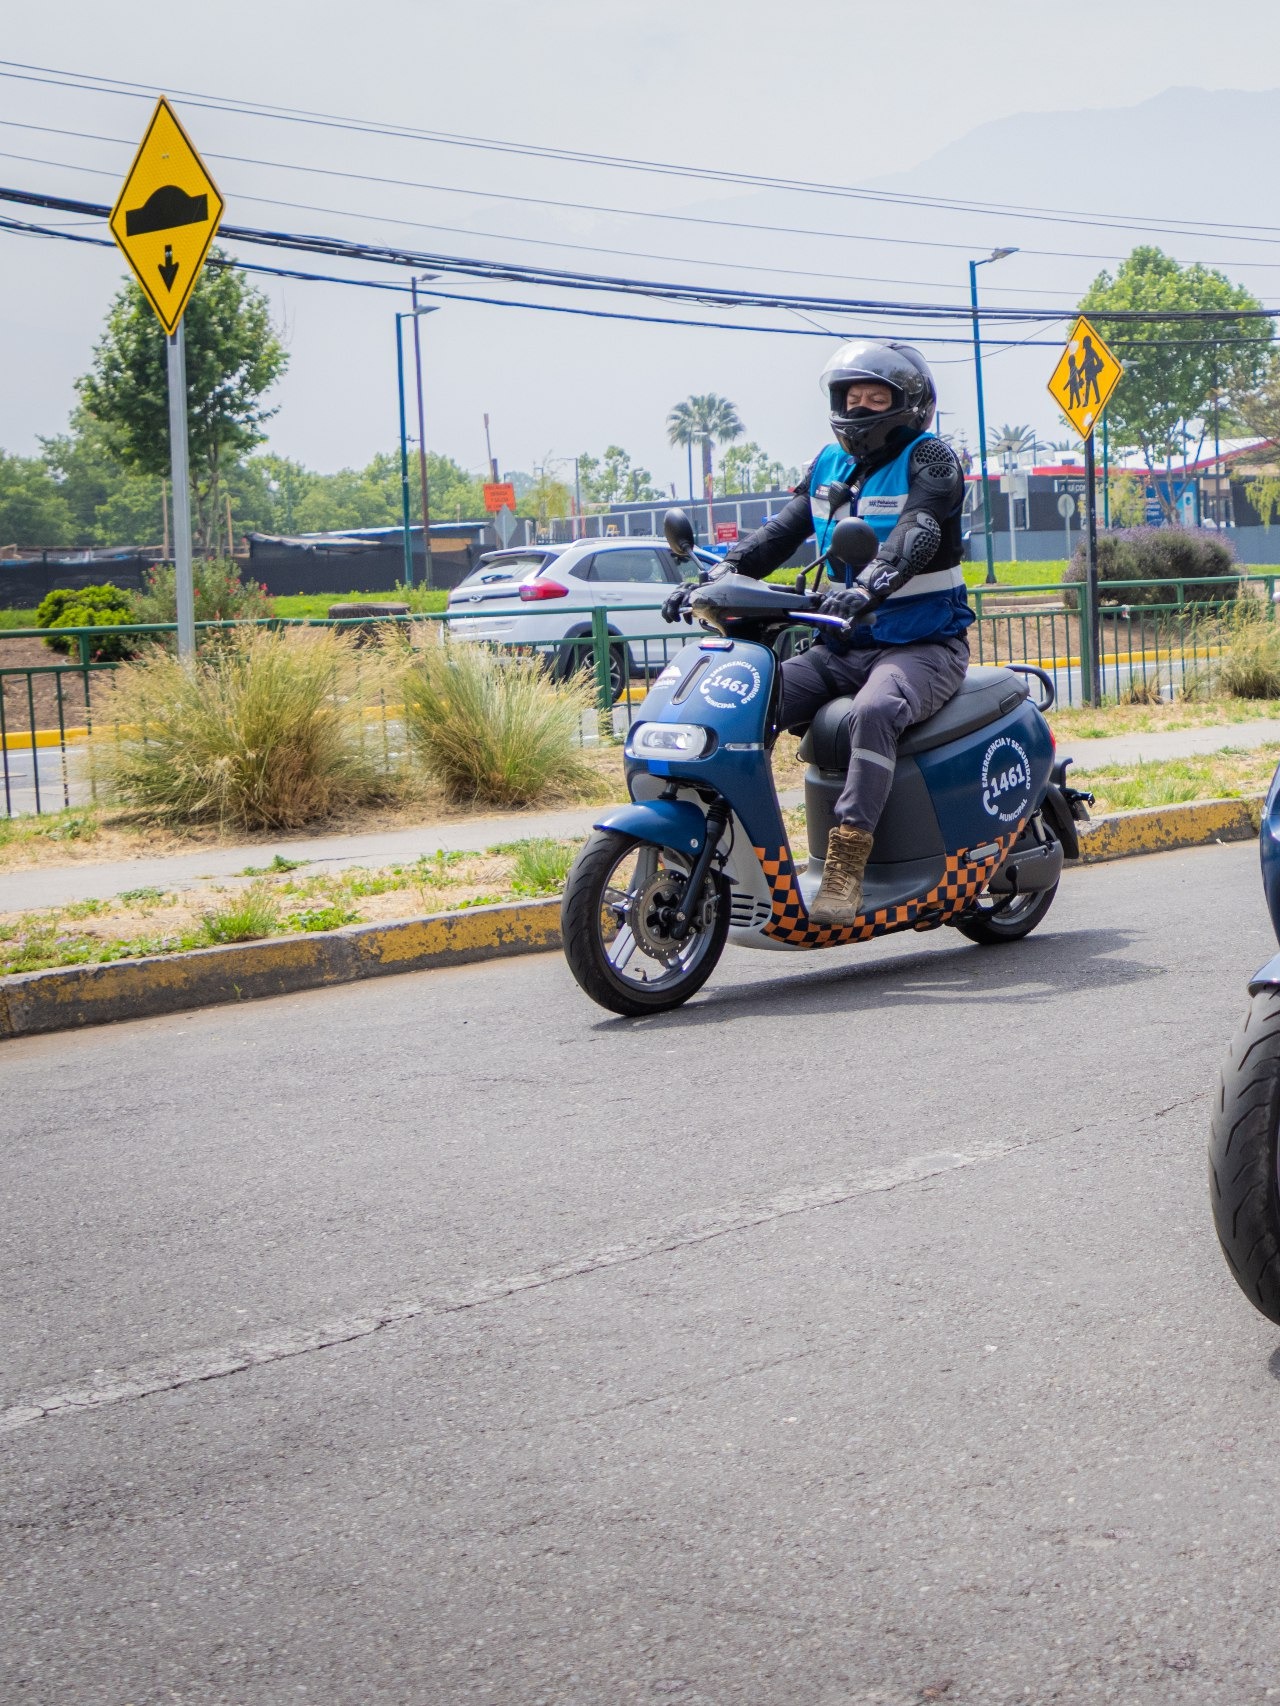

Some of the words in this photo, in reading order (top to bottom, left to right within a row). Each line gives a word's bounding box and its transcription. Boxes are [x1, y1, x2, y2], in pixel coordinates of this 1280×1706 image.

[711, 675, 750, 697] 1461
[981, 737, 1006, 789] EMERGENCIA
[1005, 737, 1011, 746] Y
[1011, 739, 1032, 790] SEGURIDAD
[990, 763, 1026, 798] 1461
[998, 798, 1028, 822] MUNICIPAL
